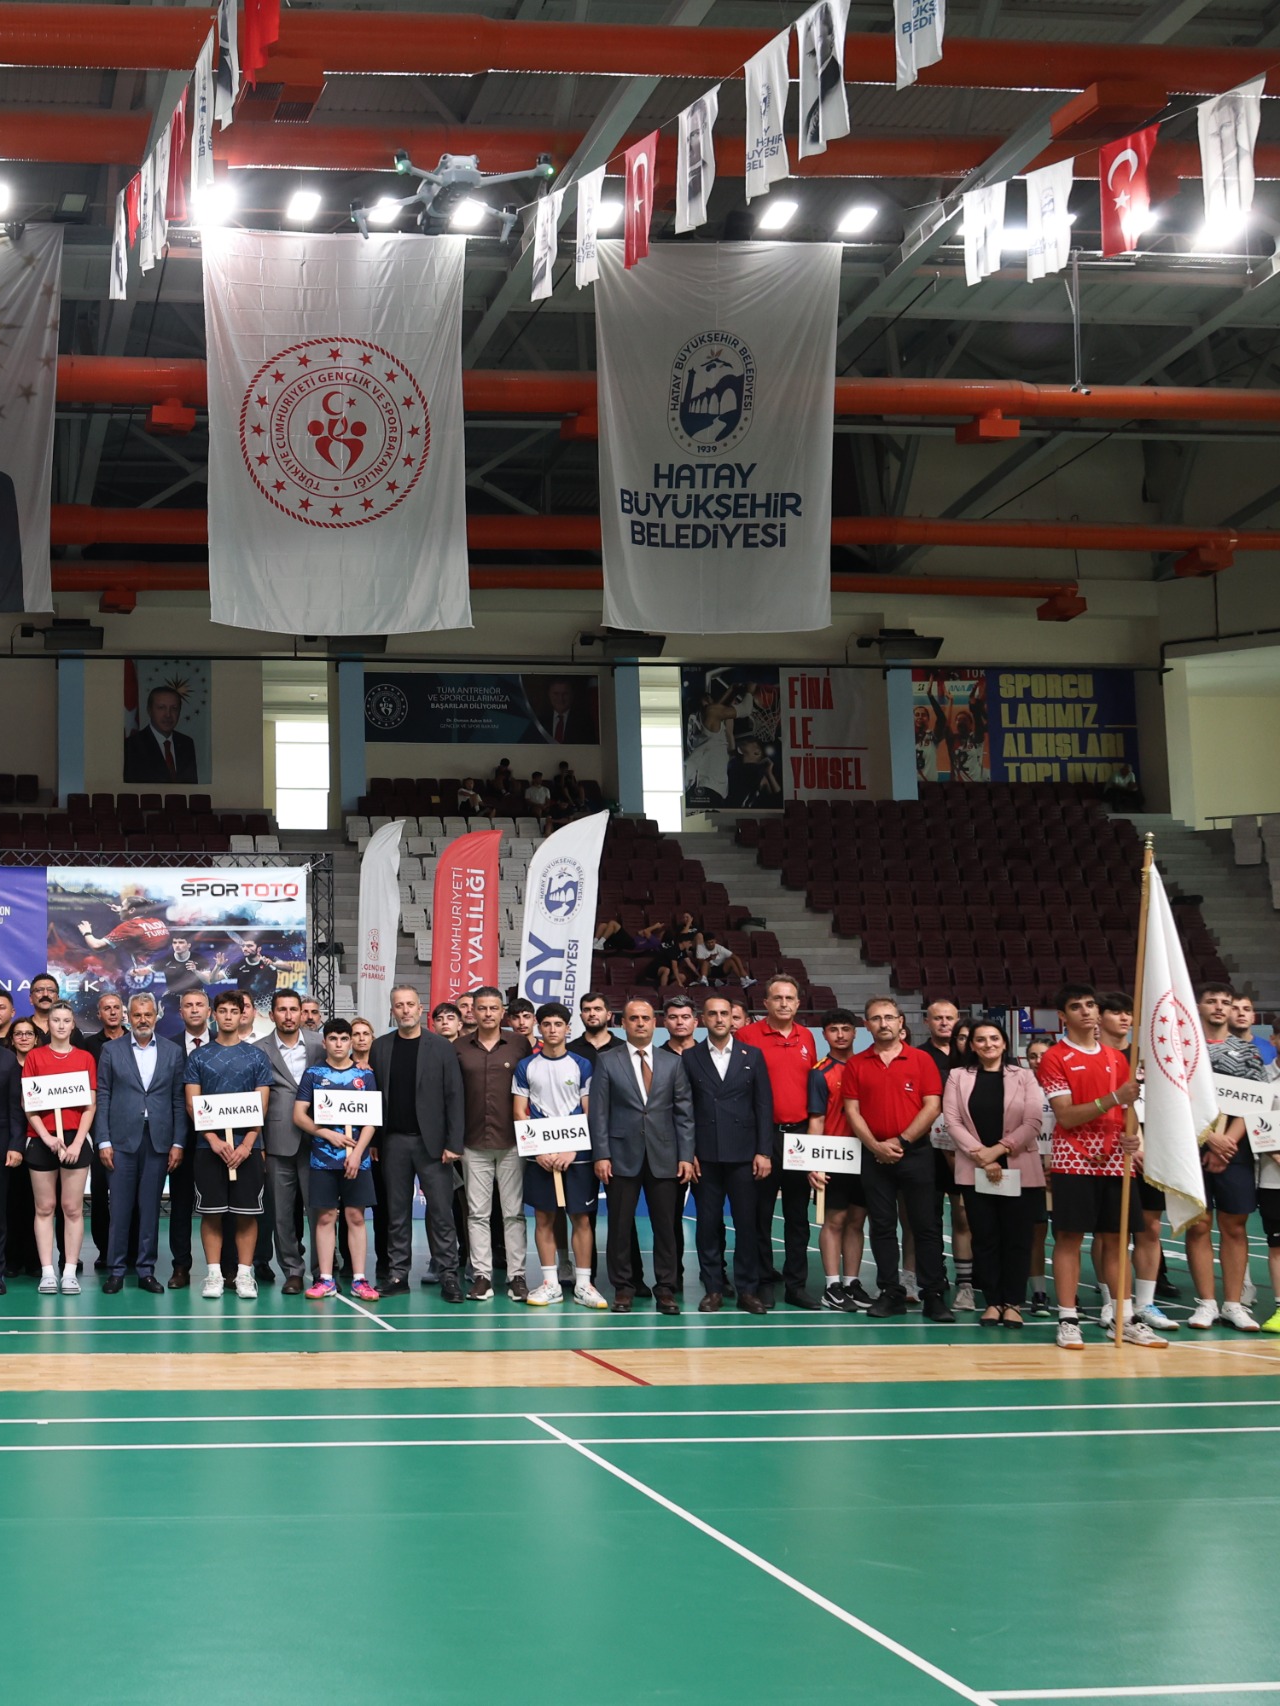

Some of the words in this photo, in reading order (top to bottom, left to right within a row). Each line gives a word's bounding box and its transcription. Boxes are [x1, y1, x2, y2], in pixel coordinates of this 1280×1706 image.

[318, 372, 372, 389] GENÇLİK
[372, 386, 386, 401] VE
[670, 374, 682, 411] HATAY
[274, 374, 316, 448] CUMHURİYETİ
[382, 401, 398, 430] SPOR
[354, 433, 398, 490] BAKANLIĞI
[697, 445, 718, 454] 1939
[280, 451, 320, 490] TÜRKİYE
[654, 462, 757, 489] HATAY
[620, 488, 802, 521] BÜYÜKŞEHİR
[630, 520, 786, 549] BELEDİYESİ
[998, 673, 1094, 698] SPORCU
[1000, 703, 1099, 728] LARIMIZ
[790, 716, 814, 749] LE
[1002, 732, 1124, 760] ALKIŞLARI
[790, 752, 866, 790] YÜKSEL
[450, 866, 464, 973] CUMHURİYETİ
[466, 868, 484, 964] VALİLİĞİ
[48, 1084, 85, 1096] AMASYA
[1216, 1088, 1264, 1104] SPARTA
[218, 1104, 259, 1116] ANKARA
[338, 1100, 368, 1113] AĞRI
[542, 1127, 586, 1141] BURSA
[812, 1146, 854, 1160] BİTLİS
